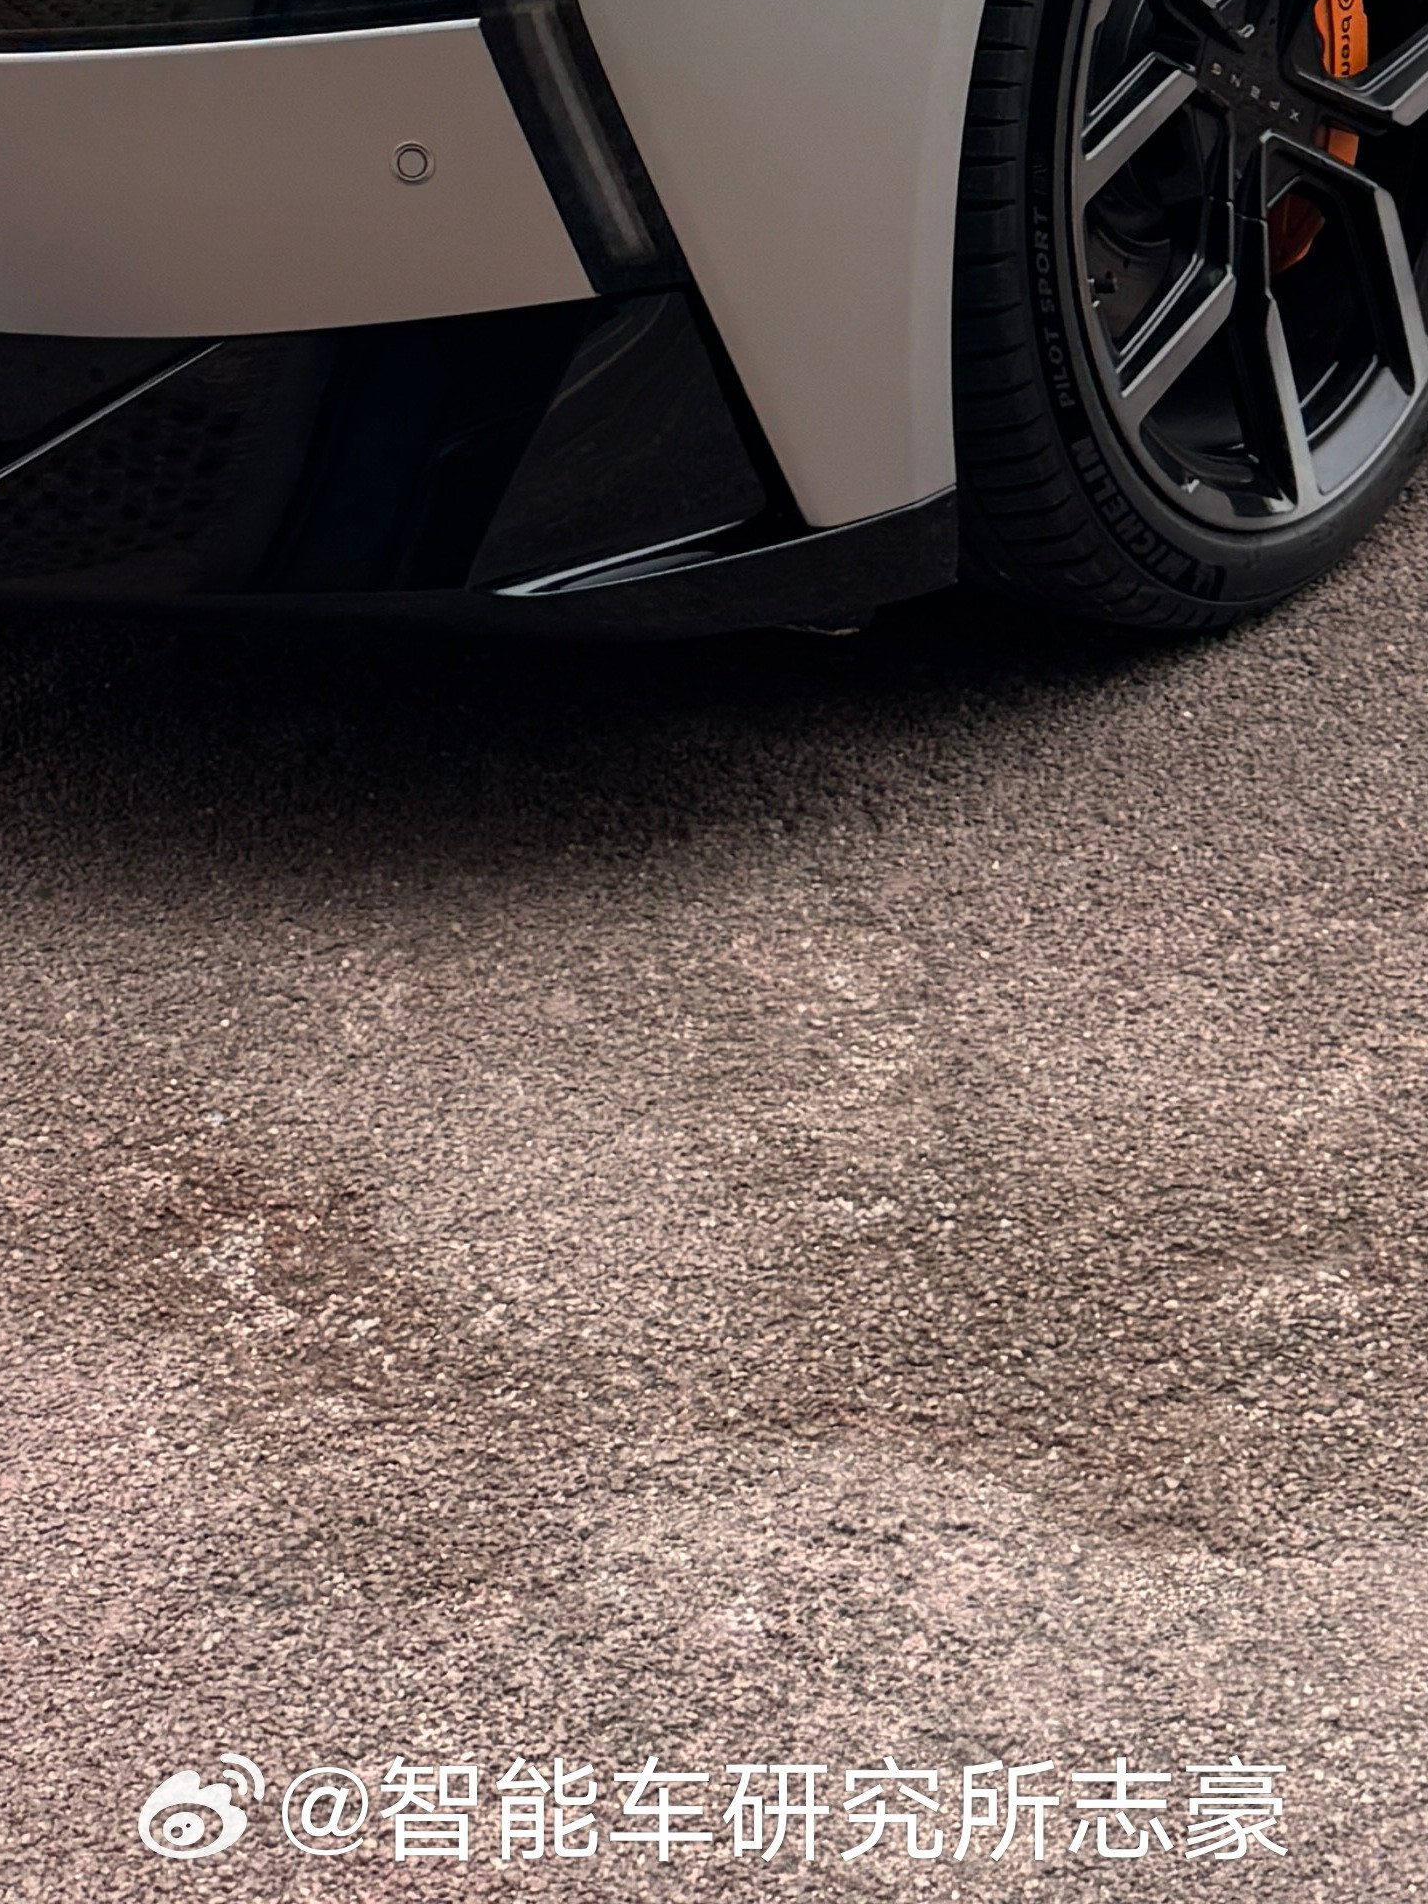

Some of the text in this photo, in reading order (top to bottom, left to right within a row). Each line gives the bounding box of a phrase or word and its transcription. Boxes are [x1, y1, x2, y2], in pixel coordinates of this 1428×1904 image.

[1033, 204, 1056, 316] SPORT
[1043, 328, 1076, 410] PILOT
[1070, 435, 1194, 582] MICHELIN
